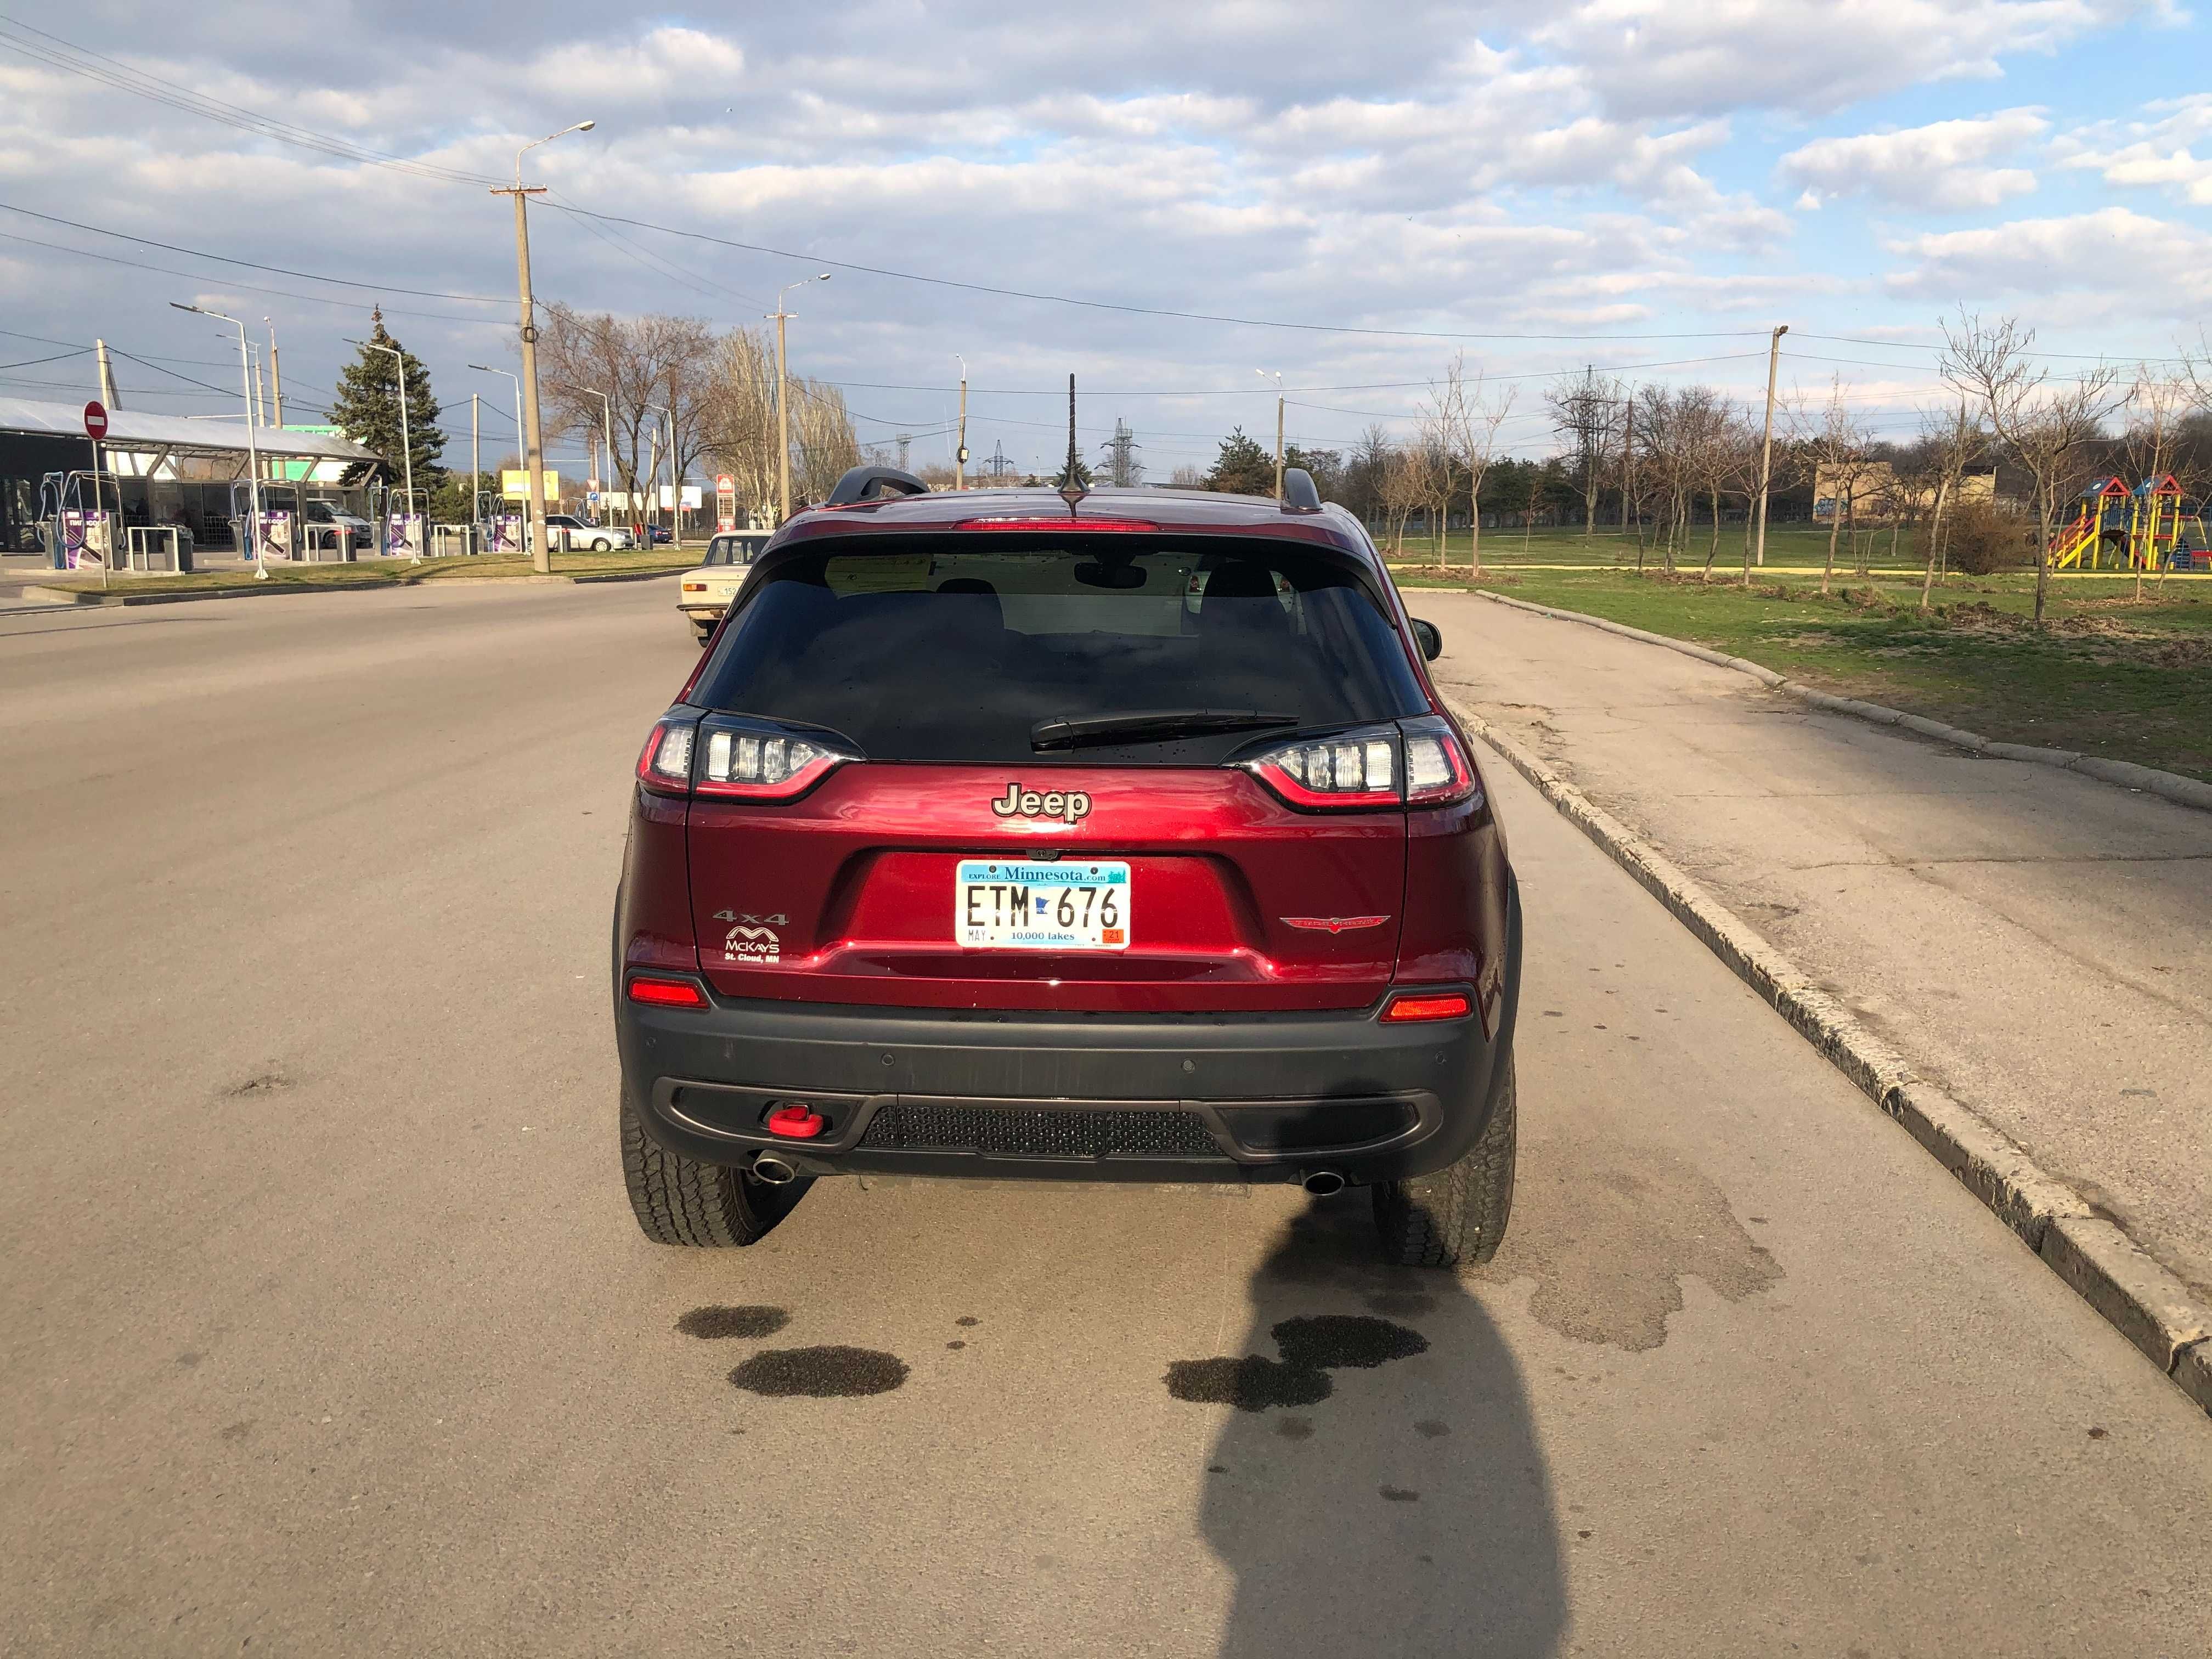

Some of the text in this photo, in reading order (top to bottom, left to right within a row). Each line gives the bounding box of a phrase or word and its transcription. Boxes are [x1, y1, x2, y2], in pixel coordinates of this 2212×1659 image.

[991, 782, 1092, 825] Jeep
[967, 885, 1118, 928] ETM 676
[968, 929, 986, 941] MAY
[1011, 932, 1075, 940] 10,000 lakes
[1109, 930, 1119, 938] 21
[725, 952, 780, 963] St. Cloud, MN
